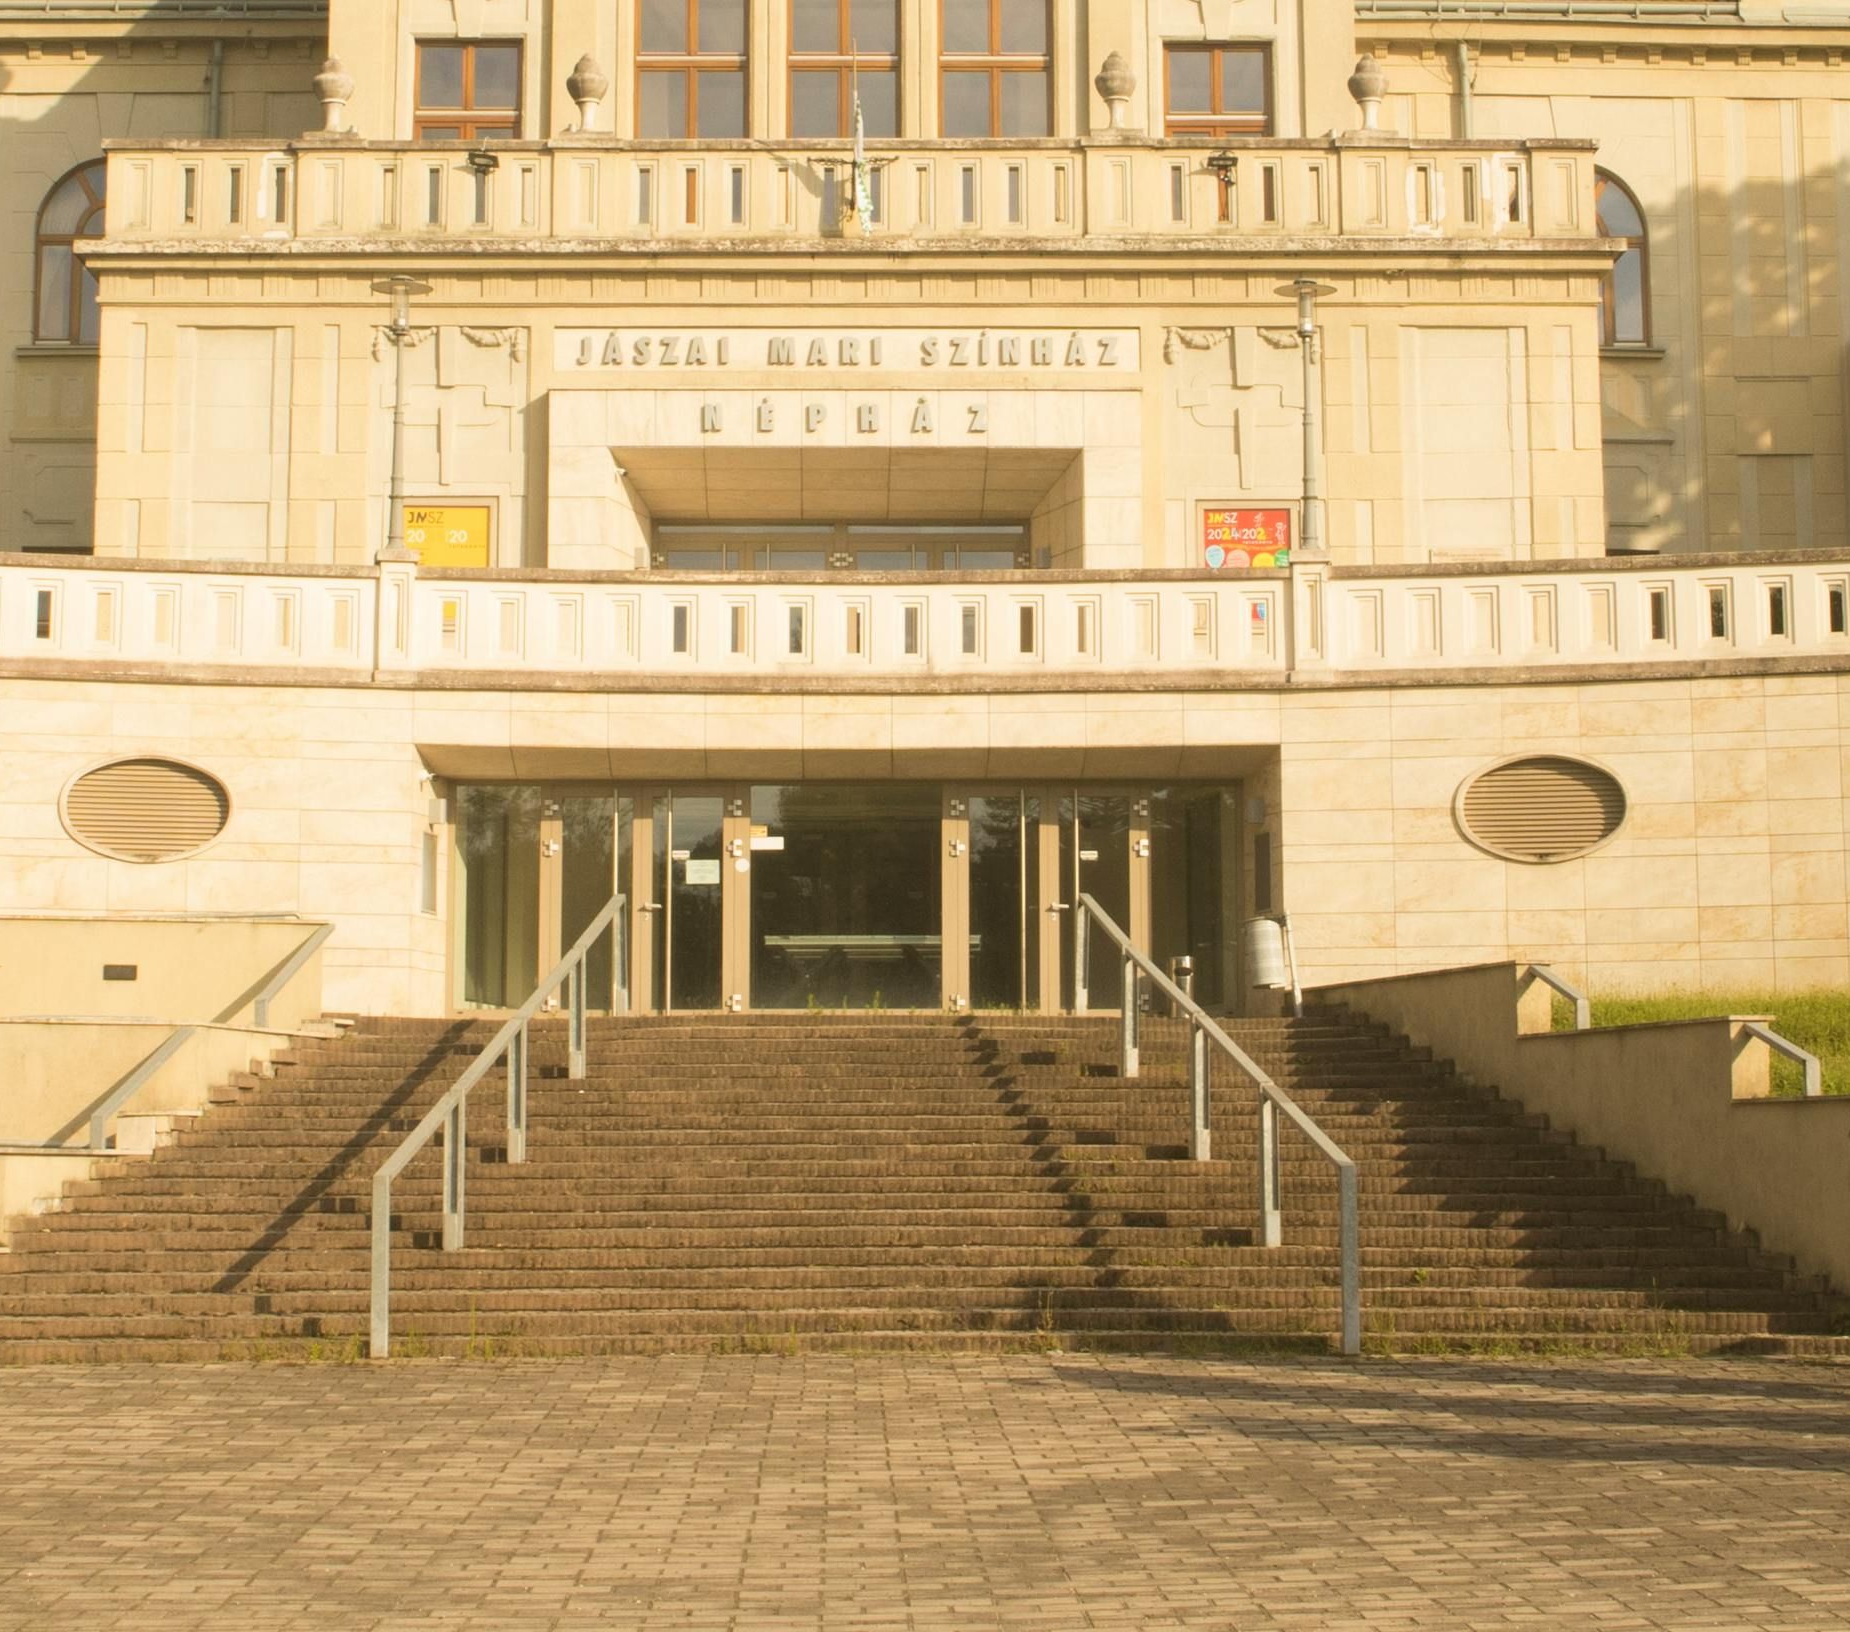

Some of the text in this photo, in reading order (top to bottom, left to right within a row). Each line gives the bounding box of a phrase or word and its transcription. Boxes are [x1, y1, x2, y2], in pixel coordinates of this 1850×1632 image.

[576, 328, 1118, 366] JÁSZAI MARI SZÍNHÁZ
[701, 396, 989, 434] NÉPHÁZ
